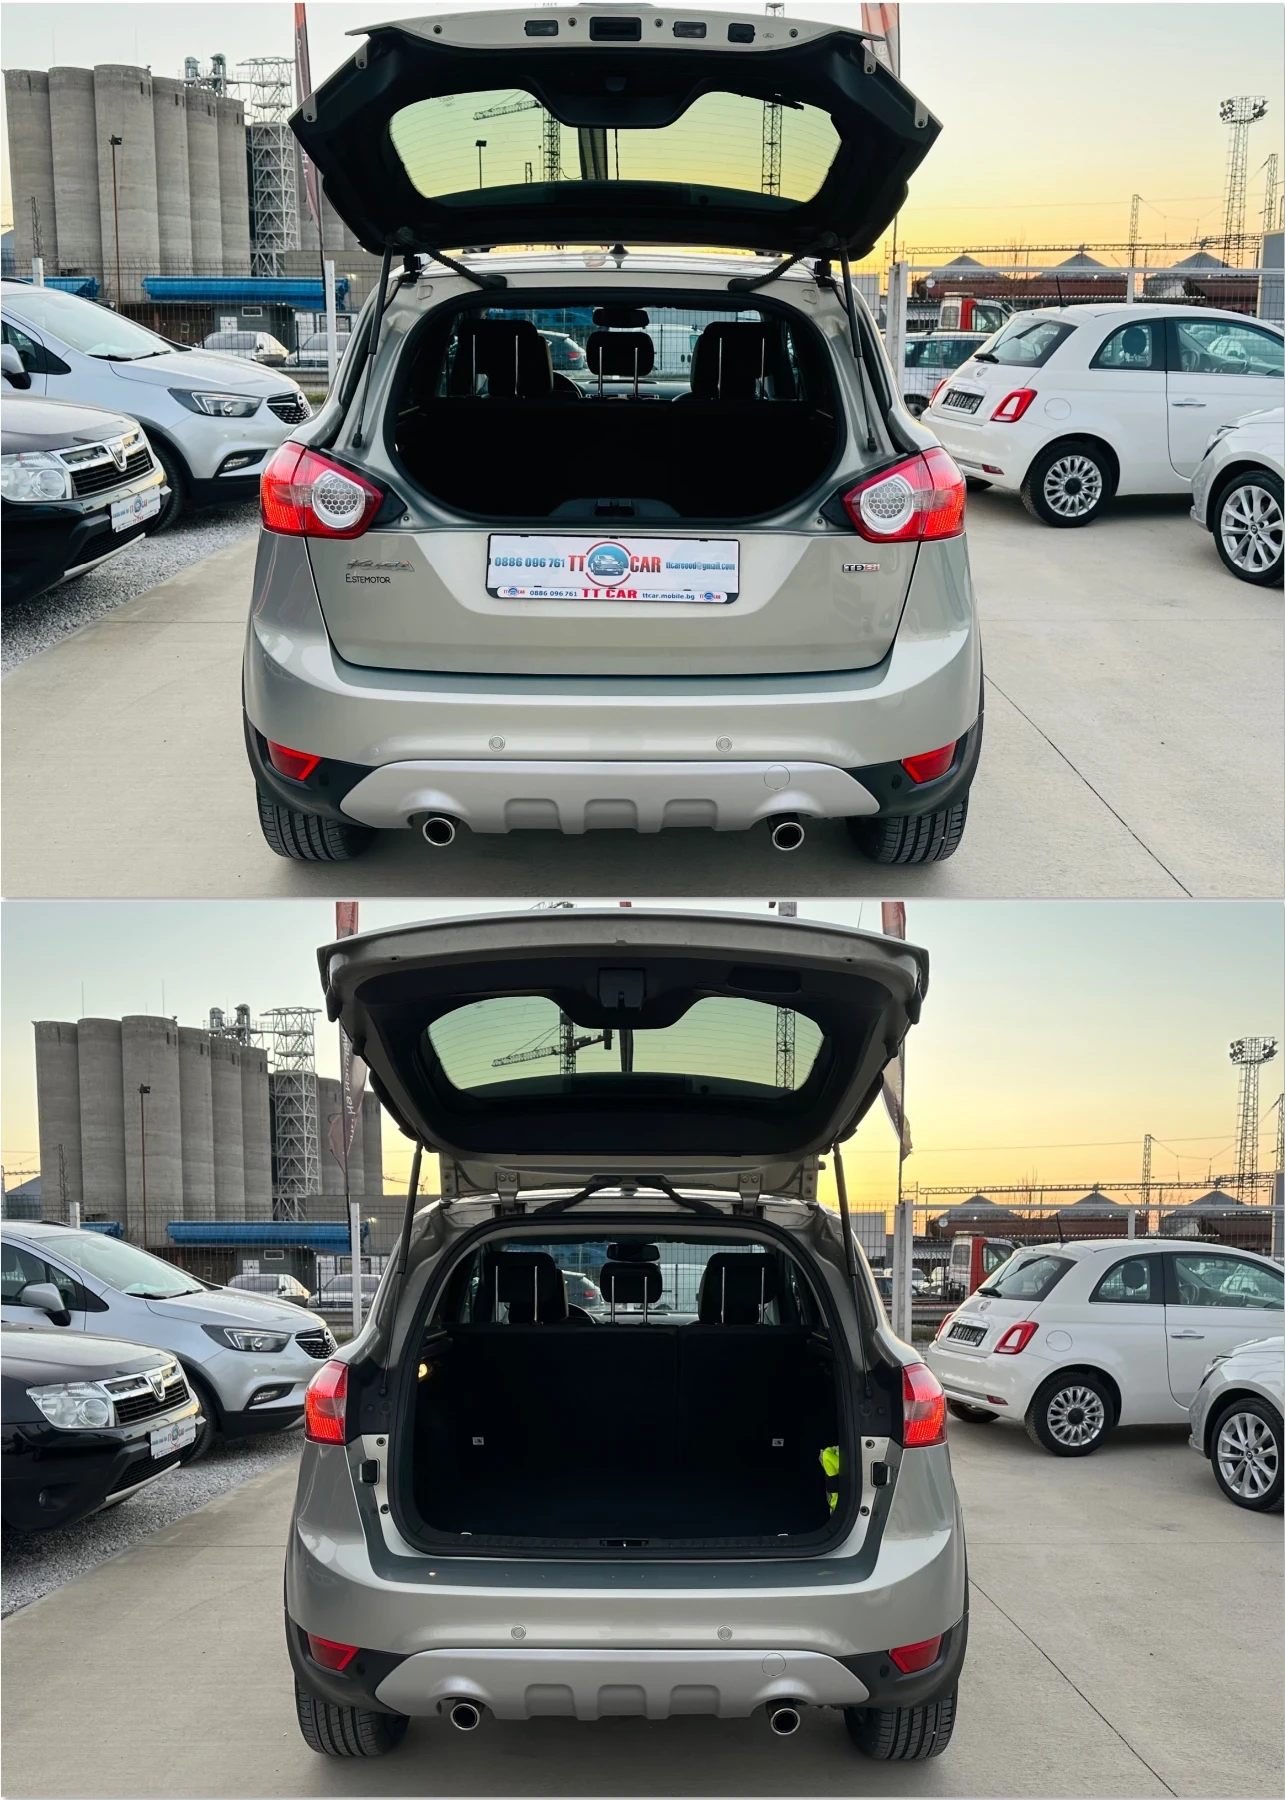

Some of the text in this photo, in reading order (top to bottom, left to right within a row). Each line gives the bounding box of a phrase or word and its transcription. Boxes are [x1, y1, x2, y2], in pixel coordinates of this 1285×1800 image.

[494, 556, 565, 568] 0886 096 761
[568, 555, 661, 573] TT CAR
[582, 588, 638, 599] TT CAR
[642, 592, 695, 600] ttcar.mobile.bg
